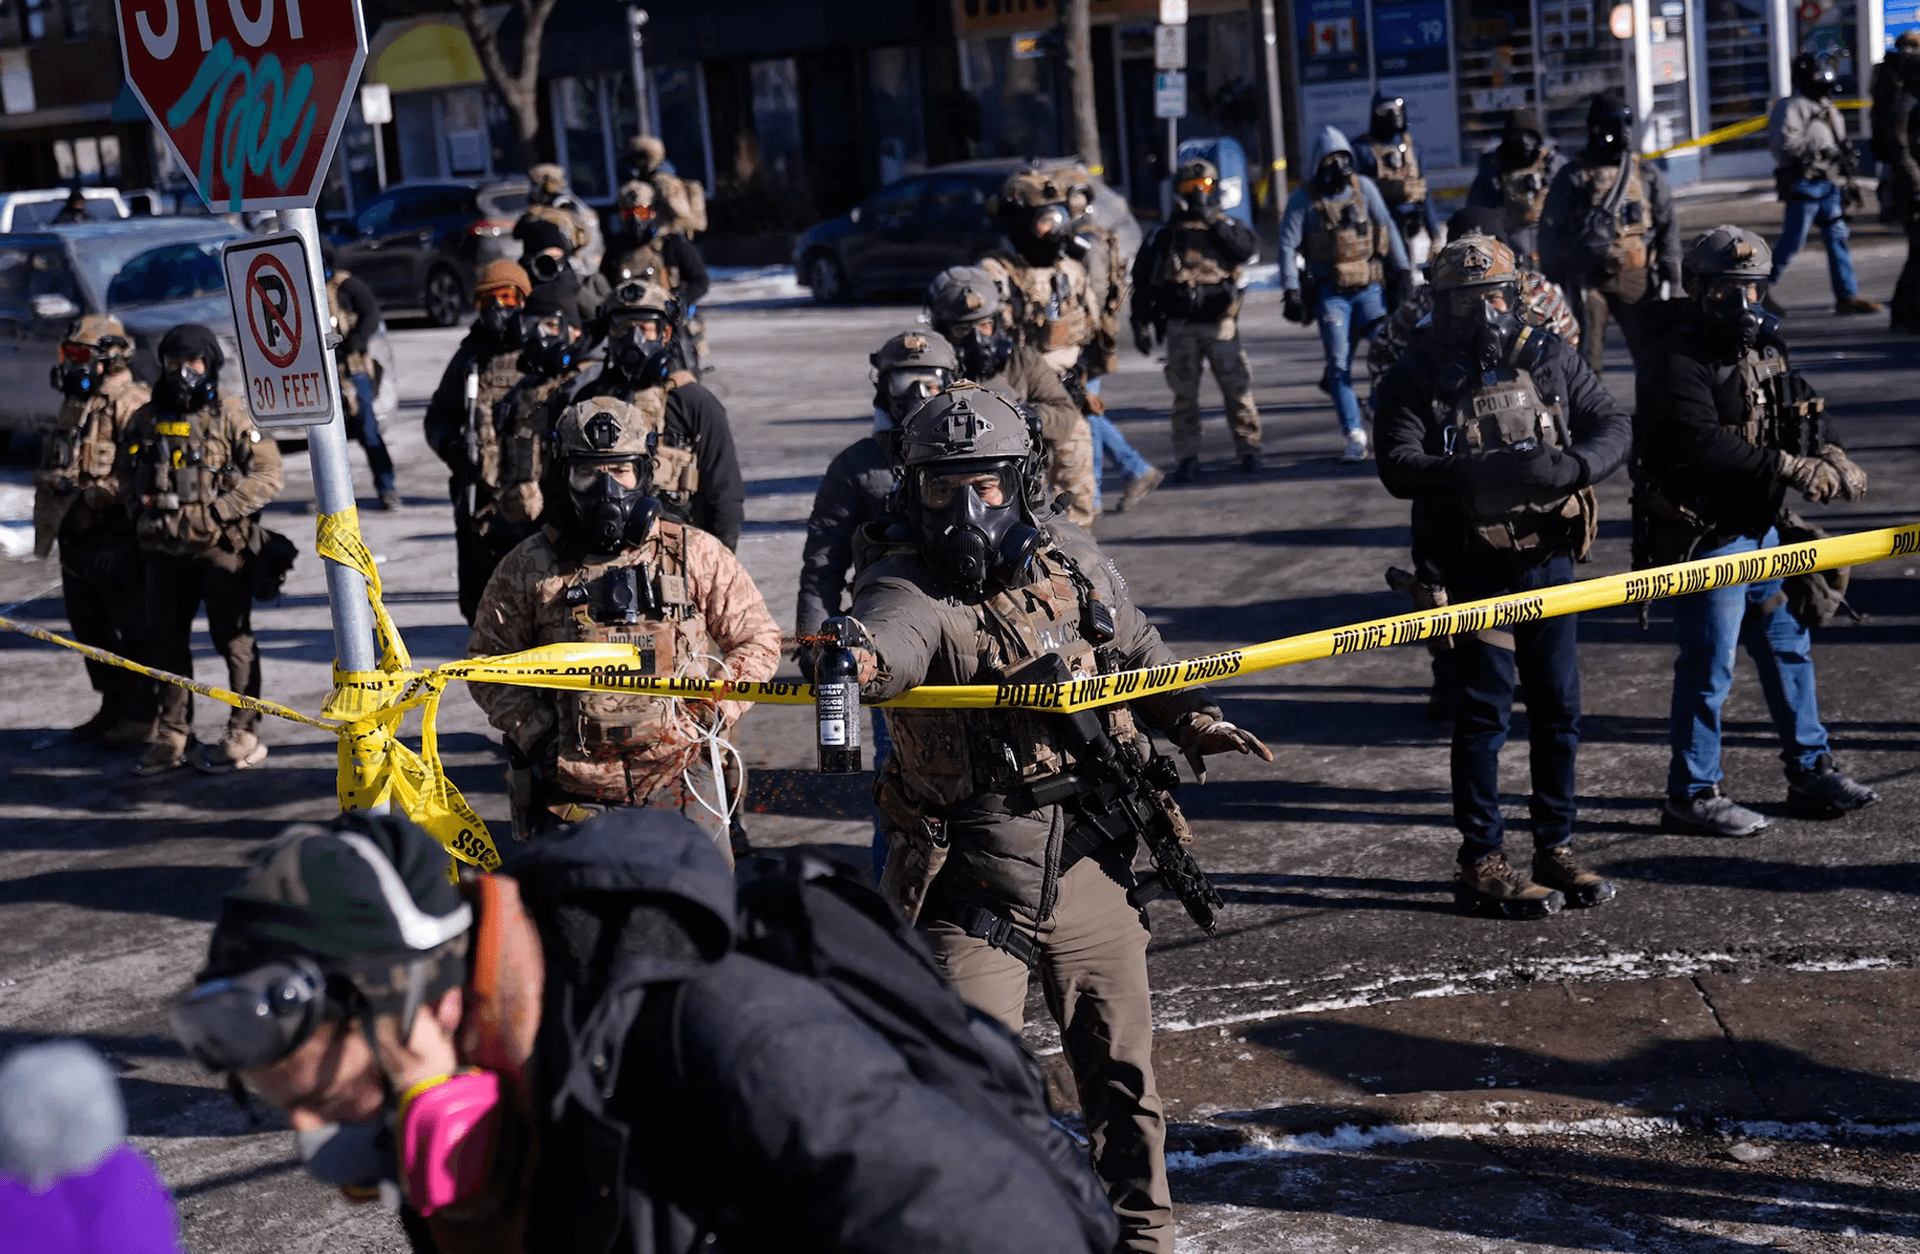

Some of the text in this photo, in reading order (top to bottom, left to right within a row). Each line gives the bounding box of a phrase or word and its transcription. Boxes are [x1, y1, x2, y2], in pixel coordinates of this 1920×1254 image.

[254, 372, 321, 410] 30 FEET
[1889, 531, 1920, 557] POLI
[1624, 548, 1818, 603] POLICE LINE DO NOT CROSS
[1331, 595, 1544, 656] POLICE LINE DO NOT CROSS
[669, 677, 716, 692] LINE
[724, 680, 750, 694] DO
[757, 681, 803, 696] NOT
[995, 650, 1243, 708] POLICE LINE DO NOT CROSS
